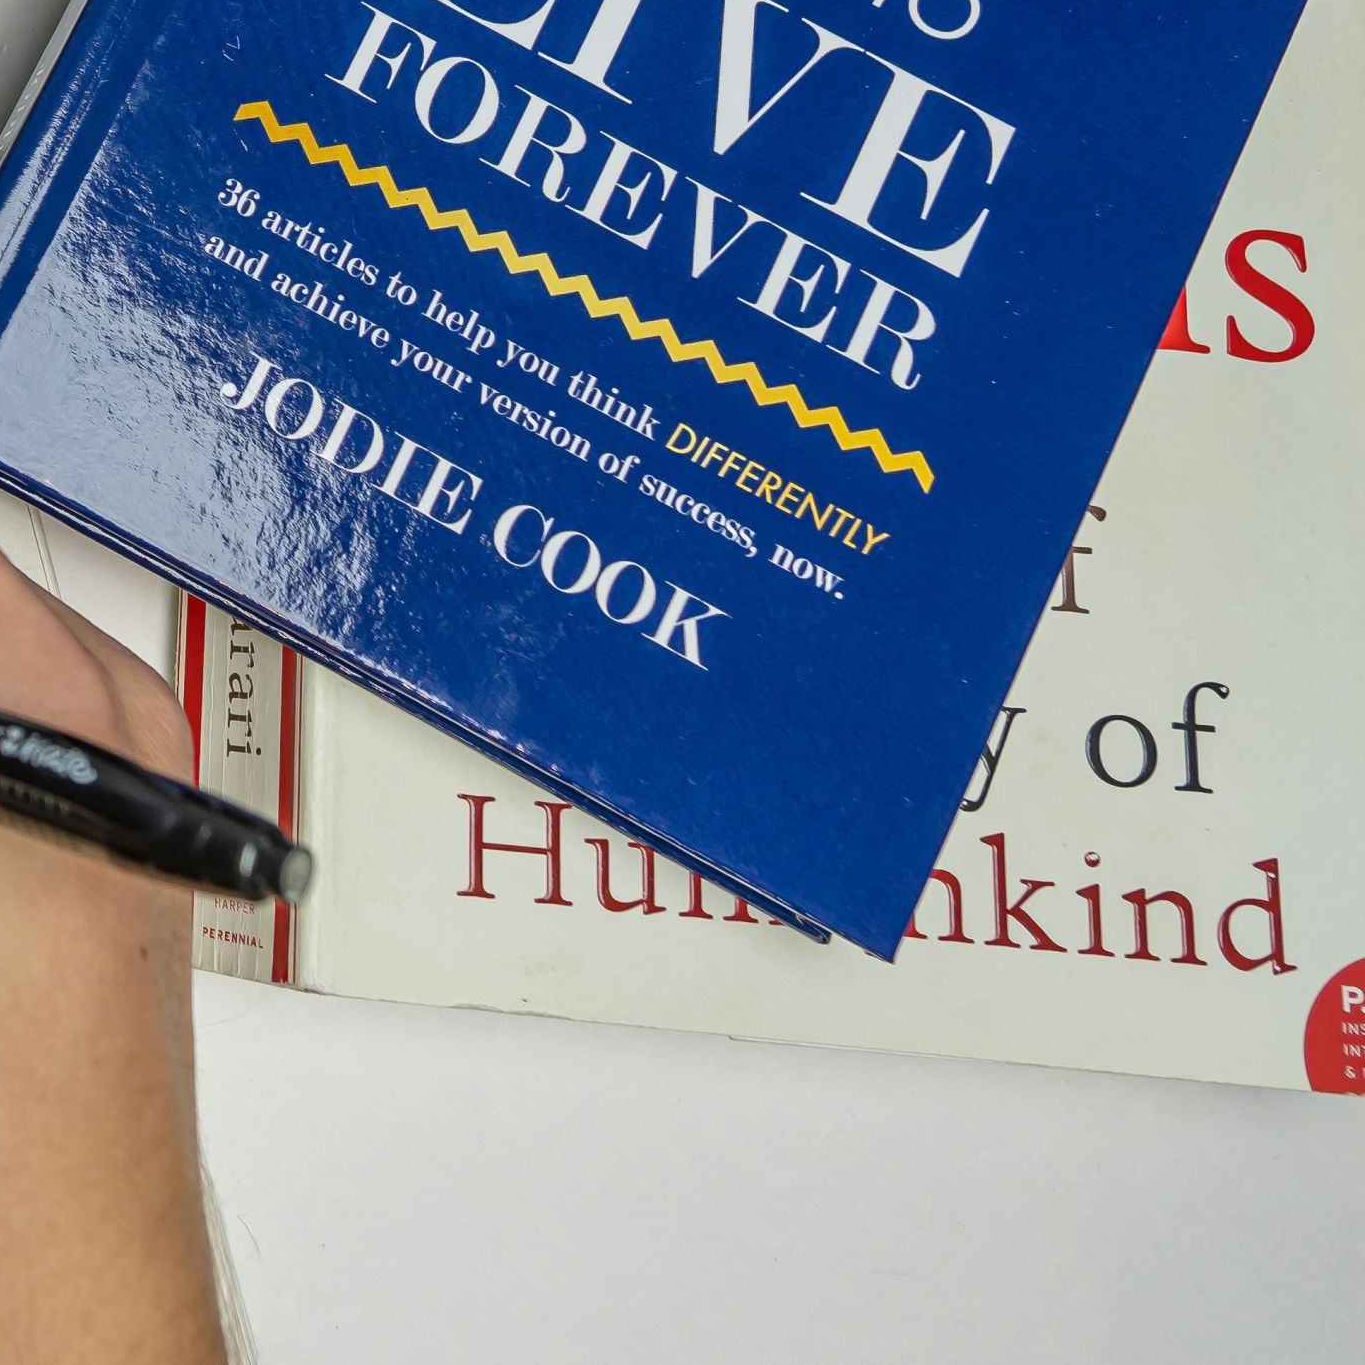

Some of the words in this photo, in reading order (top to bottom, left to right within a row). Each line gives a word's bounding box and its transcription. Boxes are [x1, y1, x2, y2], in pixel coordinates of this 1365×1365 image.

[325, 2, 935, 389] FOREVER
[203, 233, 269, 282] and
[272, 274, 389, 347] achieve
[391, 339, 471, 392] your
[481, 383, 590, 461] version
[599, 453, 640, 482] of
[640, 475, 757, 557] success,
[769, 545, 843, 599] now.
[218, 179, 260, 216] 36
[262, 211, 379, 285] articles
[387, 272, 416, 305] to
[422, 290, 495, 354] help
[497, 340, 559, 385] you
[568, 371, 660, 440] think
[666, 423, 891, 557] DIFFERENTLY
[221, 353, 482, 536] JODIE
[494, 505, 728, 670] COOK
[1085, 681, 1230, 795] of
[202, 927, 265, 950] PERENNIAL
[214, 897, 256, 915] HARPER
